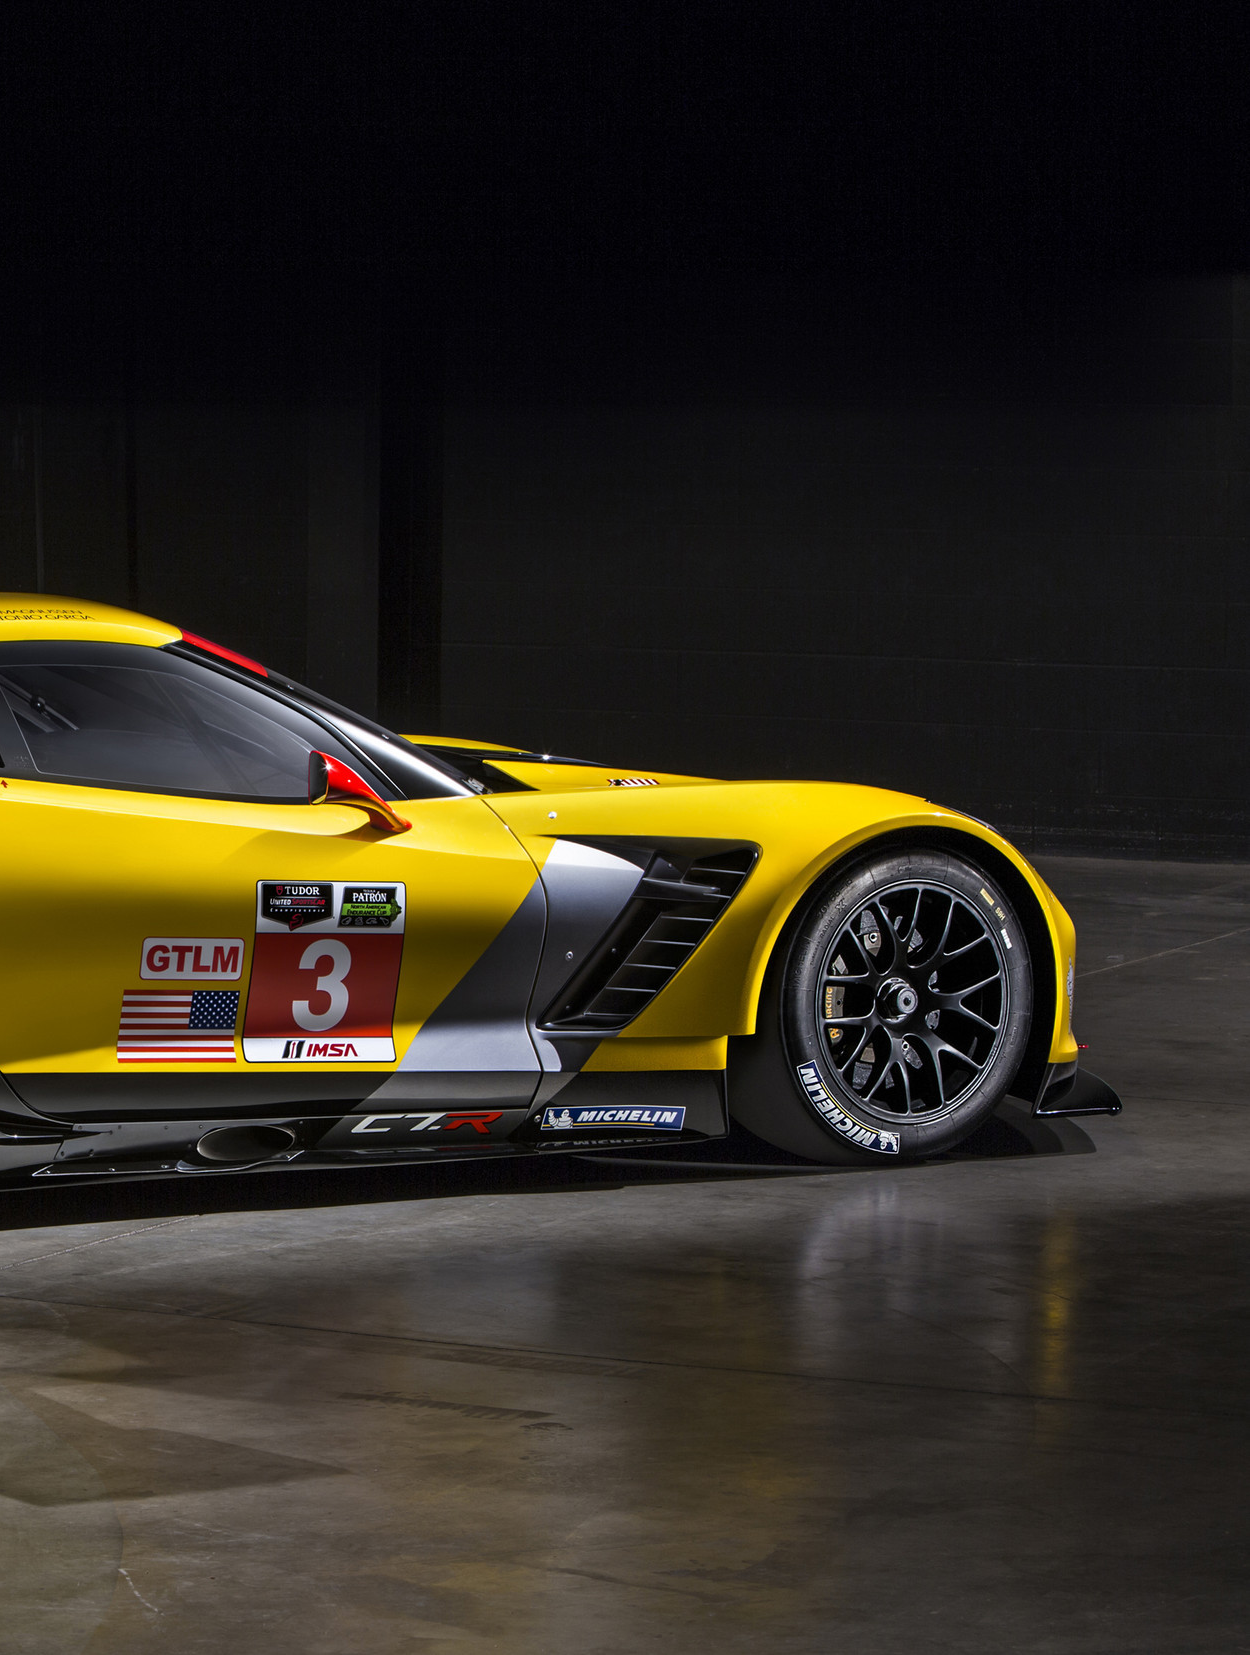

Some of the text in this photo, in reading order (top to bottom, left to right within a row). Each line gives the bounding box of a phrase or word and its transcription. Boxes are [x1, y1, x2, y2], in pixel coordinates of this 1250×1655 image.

[284, 886, 320, 895] TUDOR
[352, 892, 387, 903] PATRÓN
[146, 945, 240, 973] GTLM
[292, 938, 352, 1032] 3
[306, 1043, 358, 1057] IMSA
[799, 1067, 877, 1146] MICHELIN
[576, 1111, 677, 1123] MICHELIN
